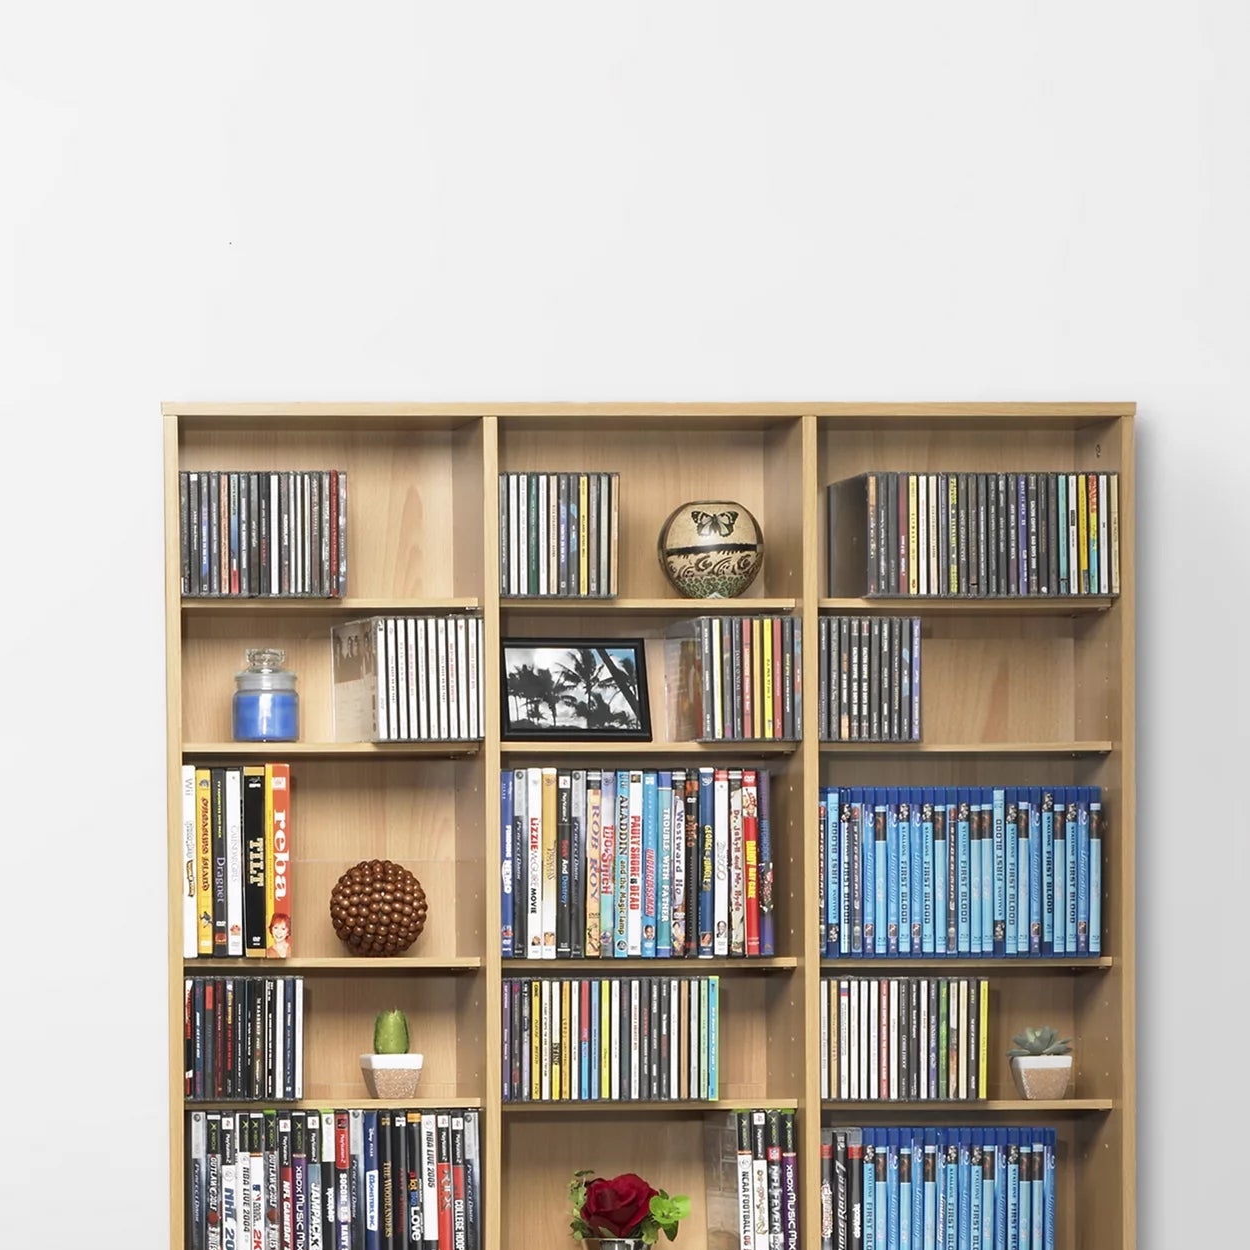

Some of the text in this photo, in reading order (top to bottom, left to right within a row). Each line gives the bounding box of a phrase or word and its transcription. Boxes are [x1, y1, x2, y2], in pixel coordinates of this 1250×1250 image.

[185, 779, 193, 795] Wii
[619, 795, 629, 856] ALADDIN
[250, 838, 264, 887] TILT
[273, 809, 290, 901] reba
[590, 804, 600, 902] ROB ROY
[676, 811, 684, 894] Westward Ho
[746, 840, 756, 898] DADDY DAY CARE
[216, 857, 226, 902] Dragnet
[560, 875, 569, 904] Destroy
[646, 848, 655, 917] UNDERCLASSMAN
[618, 892, 627, 914] Magic
[426, 1131, 435, 1188] NBA LIVE 2005
[771, 1166, 780, 1190] NFL
[225, 1188, 234, 1221] NHL
[340, 1173, 348, 1205] SOCOM:
[383, 1161, 393, 1238] THE WOODLANDERS
[742, 1171, 752, 1246] NCAA FOOTBALL 06
[283, 1201, 291, 1243] GAMEDAY
[297, 1194, 306, 1231] MUSIC
[455, 1200, 464, 1231] COLLEGE
[771, 1194, 780, 1232] FEVER
[787, 1193, 796, 1229] MUSIC
